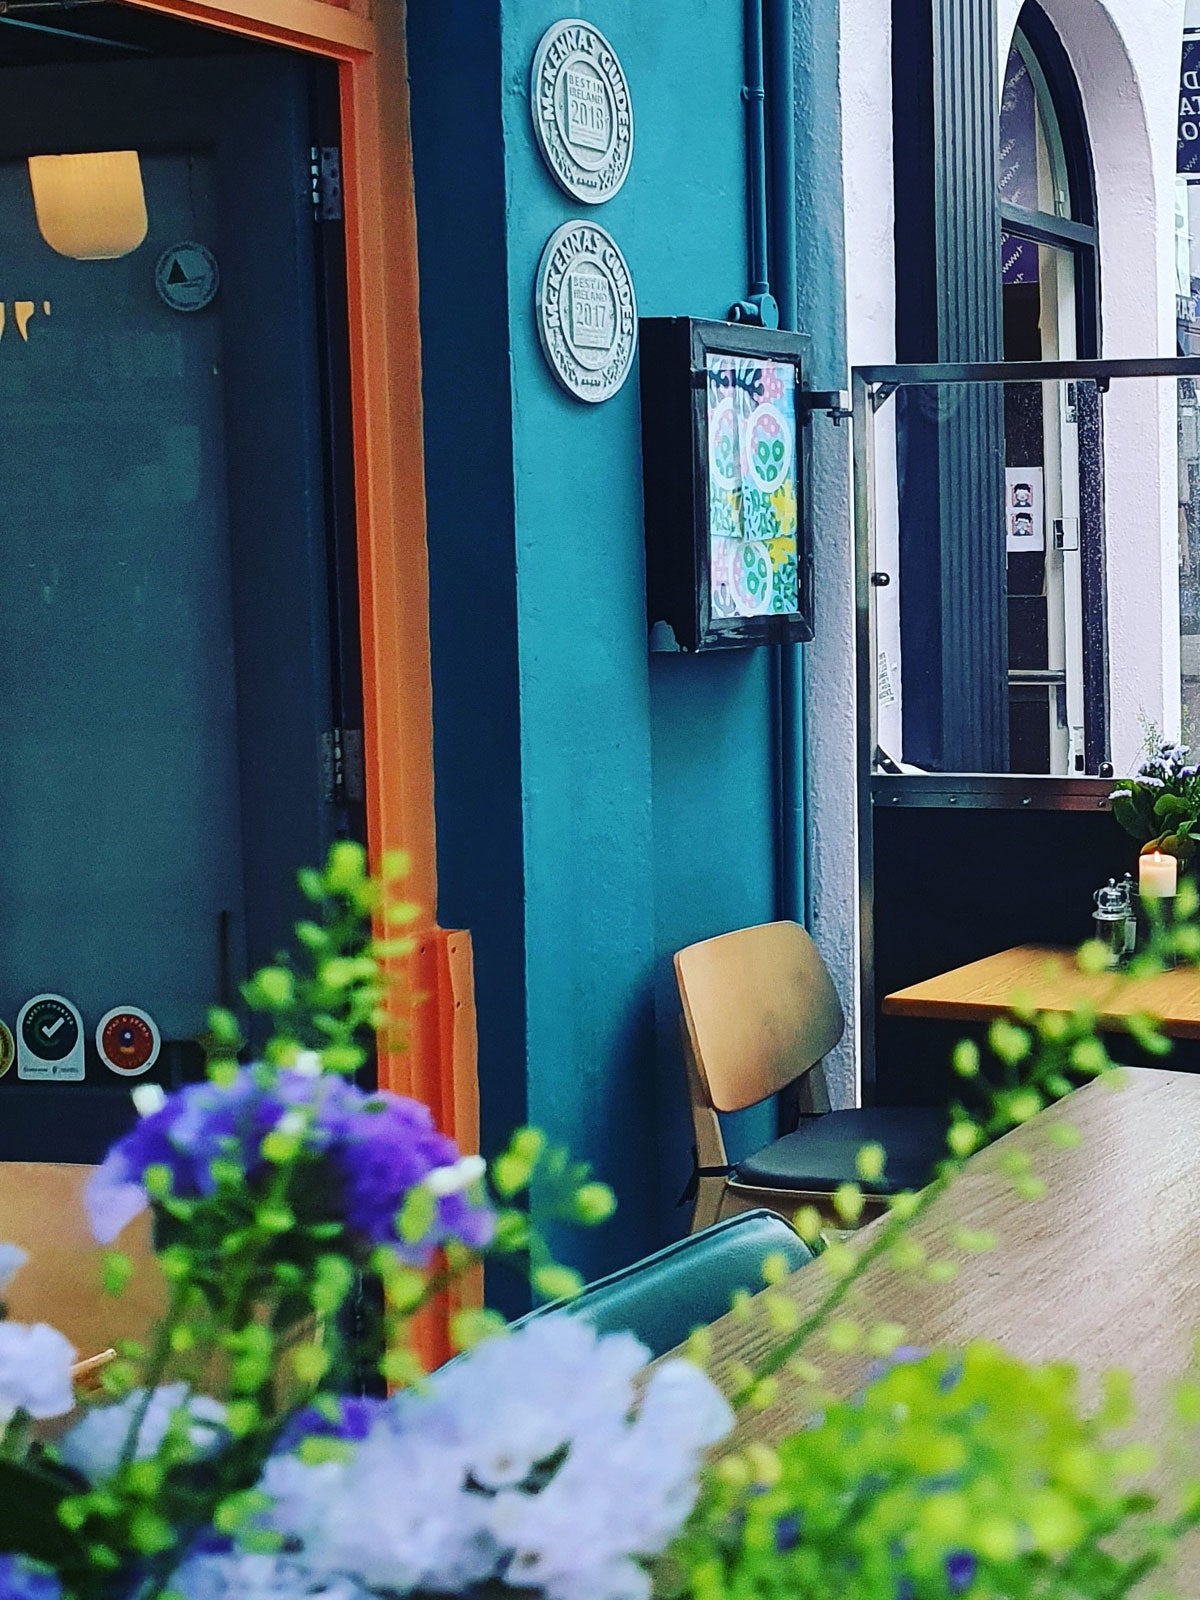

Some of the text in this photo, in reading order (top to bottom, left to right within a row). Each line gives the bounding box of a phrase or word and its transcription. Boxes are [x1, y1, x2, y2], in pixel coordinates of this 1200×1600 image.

[568, 74, 590, 89] BEST
[569, 86, 603, 104] IRELAND
[600, 50, 630, 143] GUIDES
[571, 101, 604, 131] 2018
[573, 276, 595, 290] BEST
[603, 247, 633, 336] GUIDES
[576, 302, 607, 328] 2017
